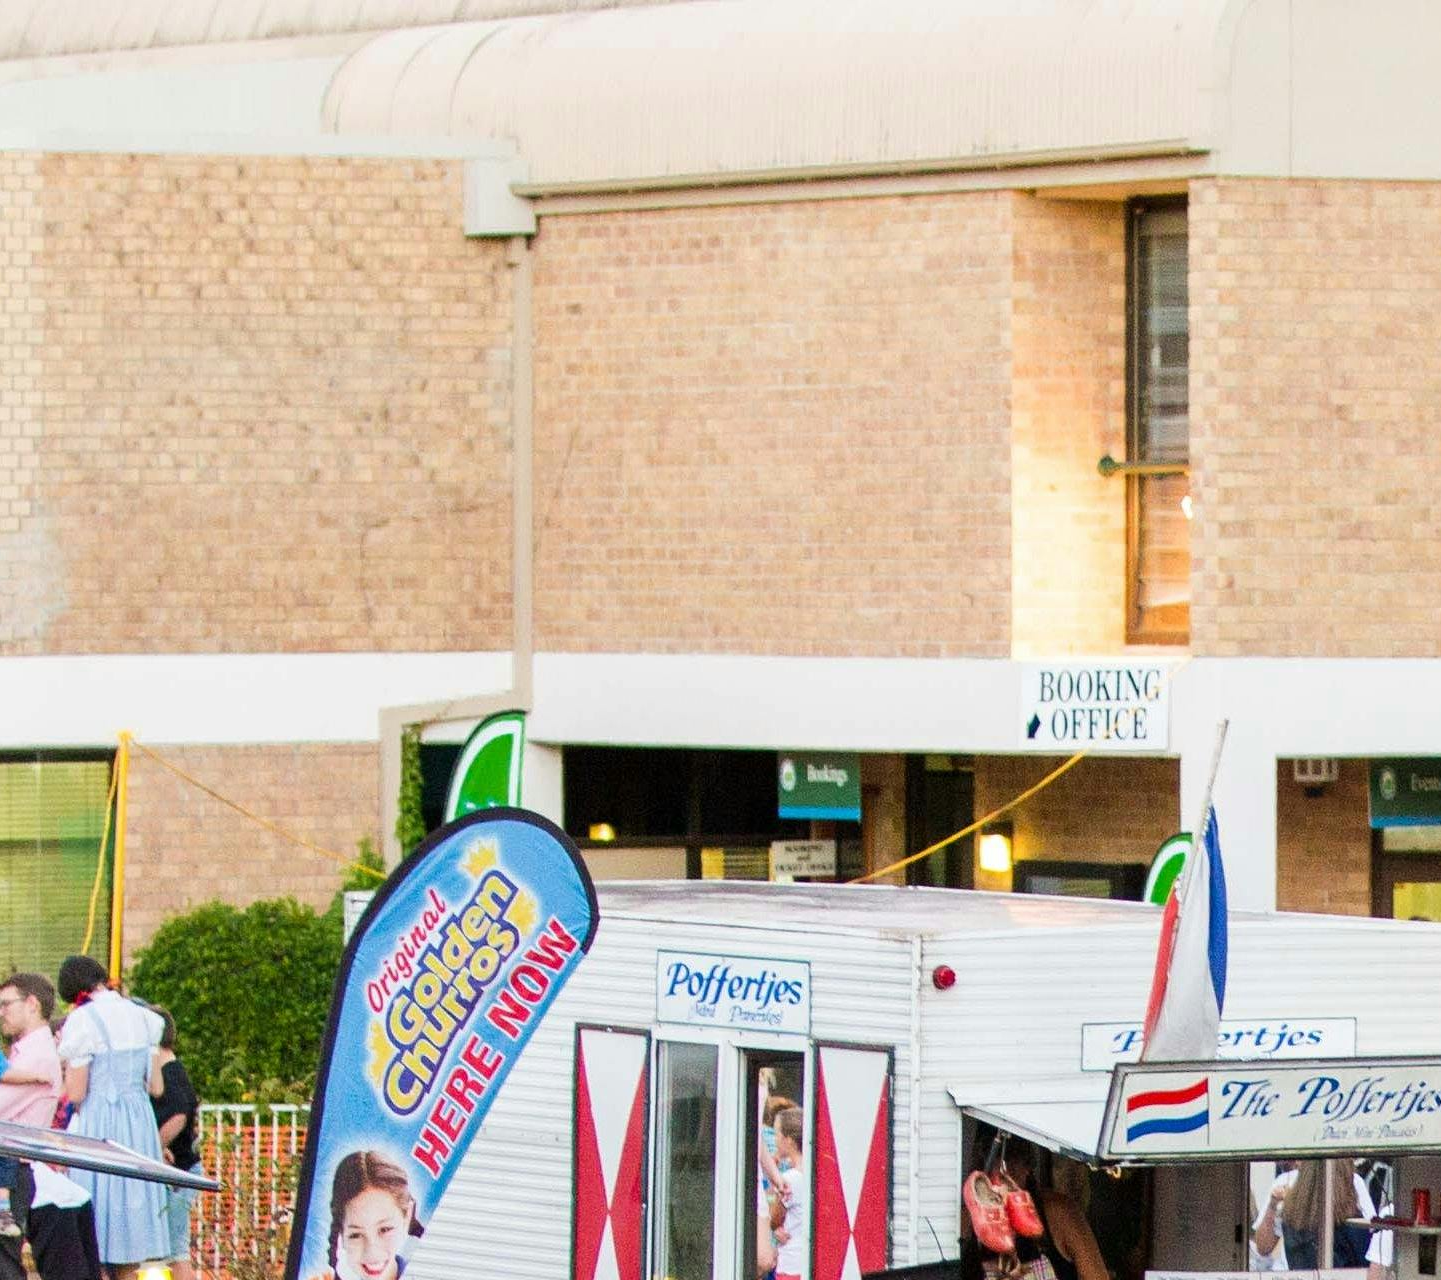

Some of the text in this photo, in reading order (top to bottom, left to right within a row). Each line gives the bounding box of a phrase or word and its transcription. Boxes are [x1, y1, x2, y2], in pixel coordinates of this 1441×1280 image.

[1040, 670, 1161, 702] BOOKING
[1052, 707, 1147, 740] OFFICE
[366, 889, 447, 1014] Original
[387, 872, 516, 1046] Golden
[665, 962, 803, 1009] Poffertjes
[384, 922, 519, 1114] Churros
[1112, 1023, 1323, 1054] Pertjes
[413, 918, 578, 1178] HERE NOW
[1219, 1080, 1279, 1120] The
